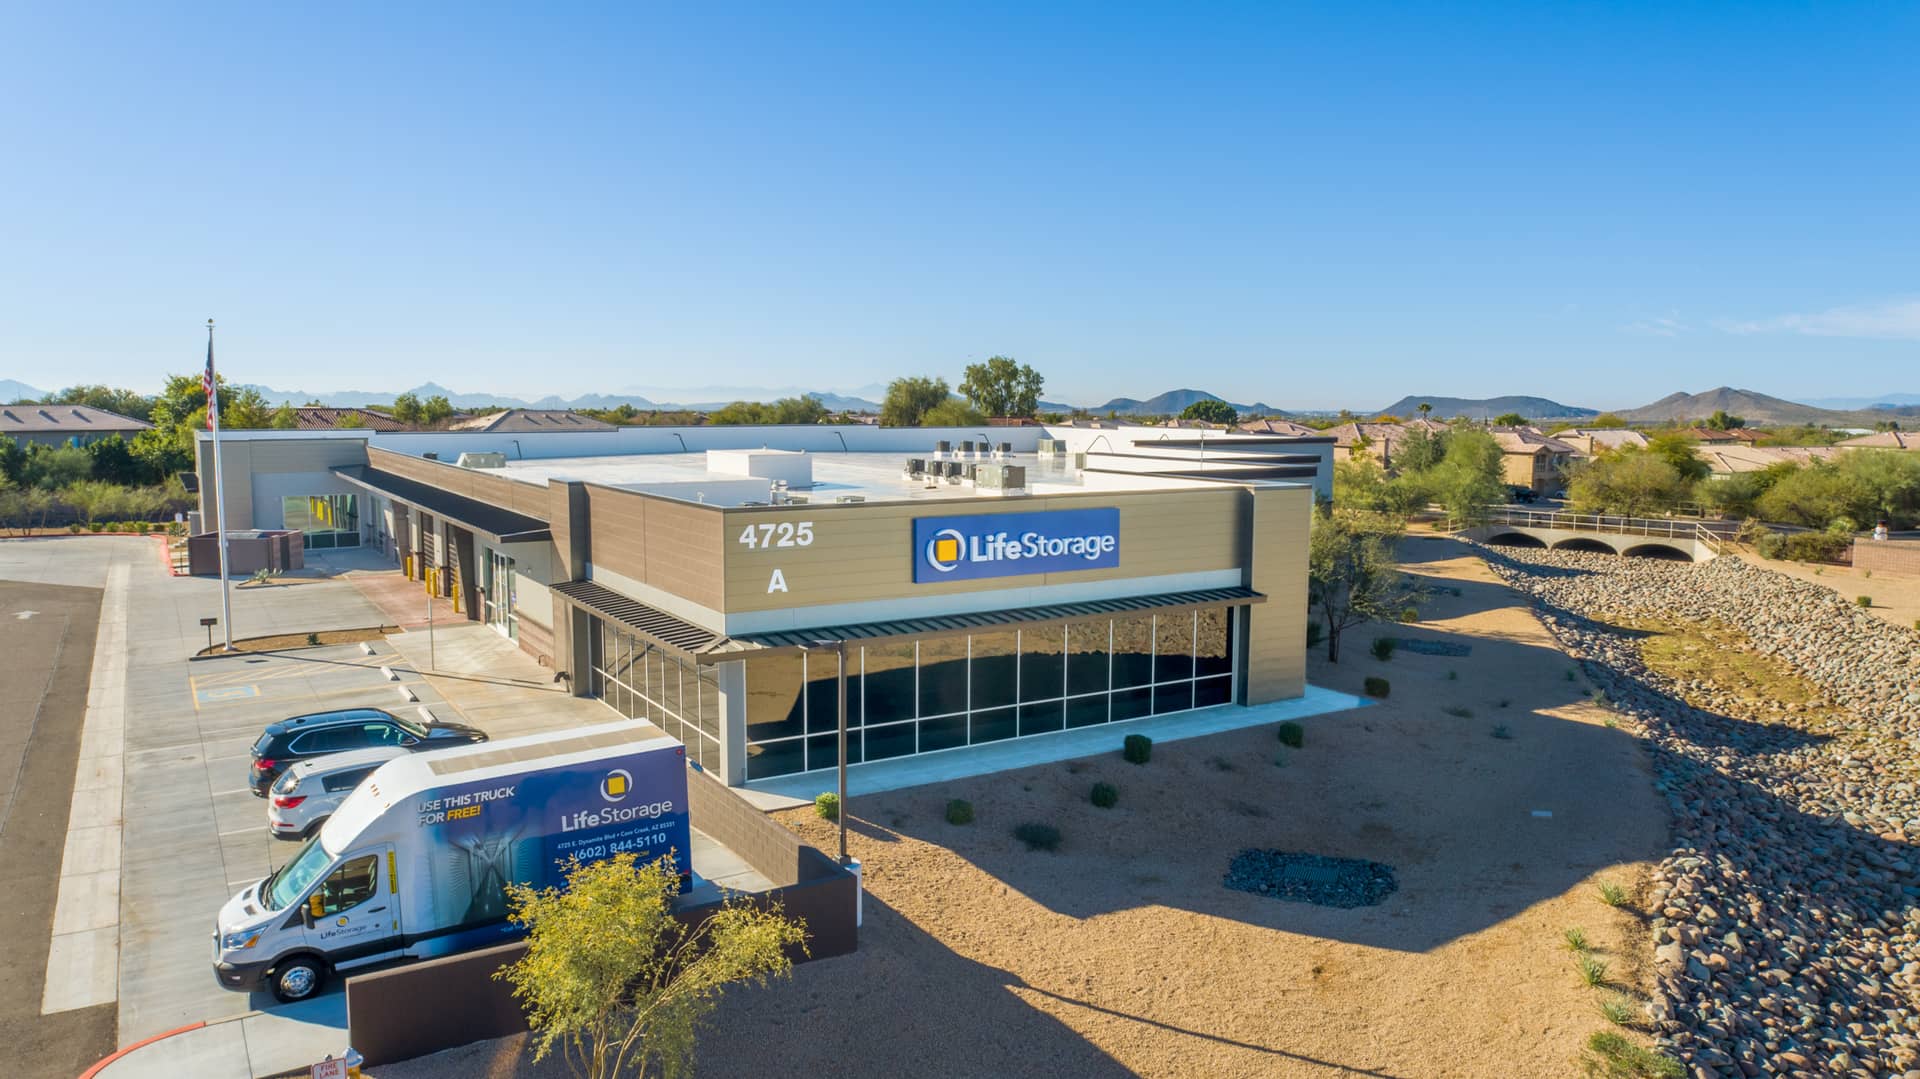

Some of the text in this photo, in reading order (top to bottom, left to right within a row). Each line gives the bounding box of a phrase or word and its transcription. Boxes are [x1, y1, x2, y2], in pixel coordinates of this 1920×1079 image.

[739, 521, 814, 549] 4725
[767, 568, 788, 593] A
[417, 786, 515, 813] USE THIS TRUCK
[419, 805, 481, 826] FOR FREE!
[574, 832, 666, 860] (602) 844-5110
